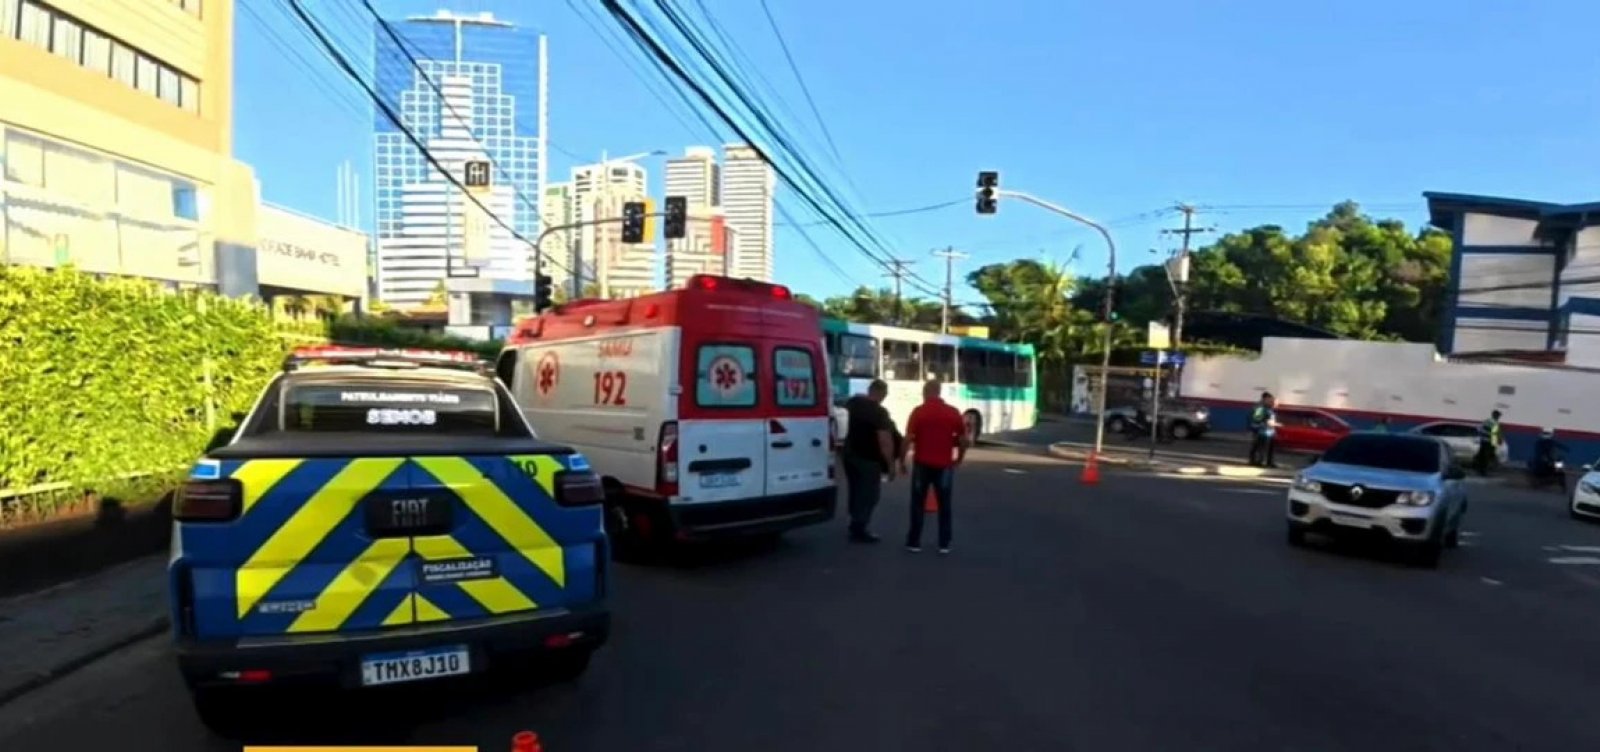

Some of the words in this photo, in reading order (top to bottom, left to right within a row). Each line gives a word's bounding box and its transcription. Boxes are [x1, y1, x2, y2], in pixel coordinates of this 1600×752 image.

[593, 370, 626, 406] 192
[783, 378, 810, 400] 192
[391, 499, 429, 515] FIAT
[374, 654, 460, 681] TMX8J10
